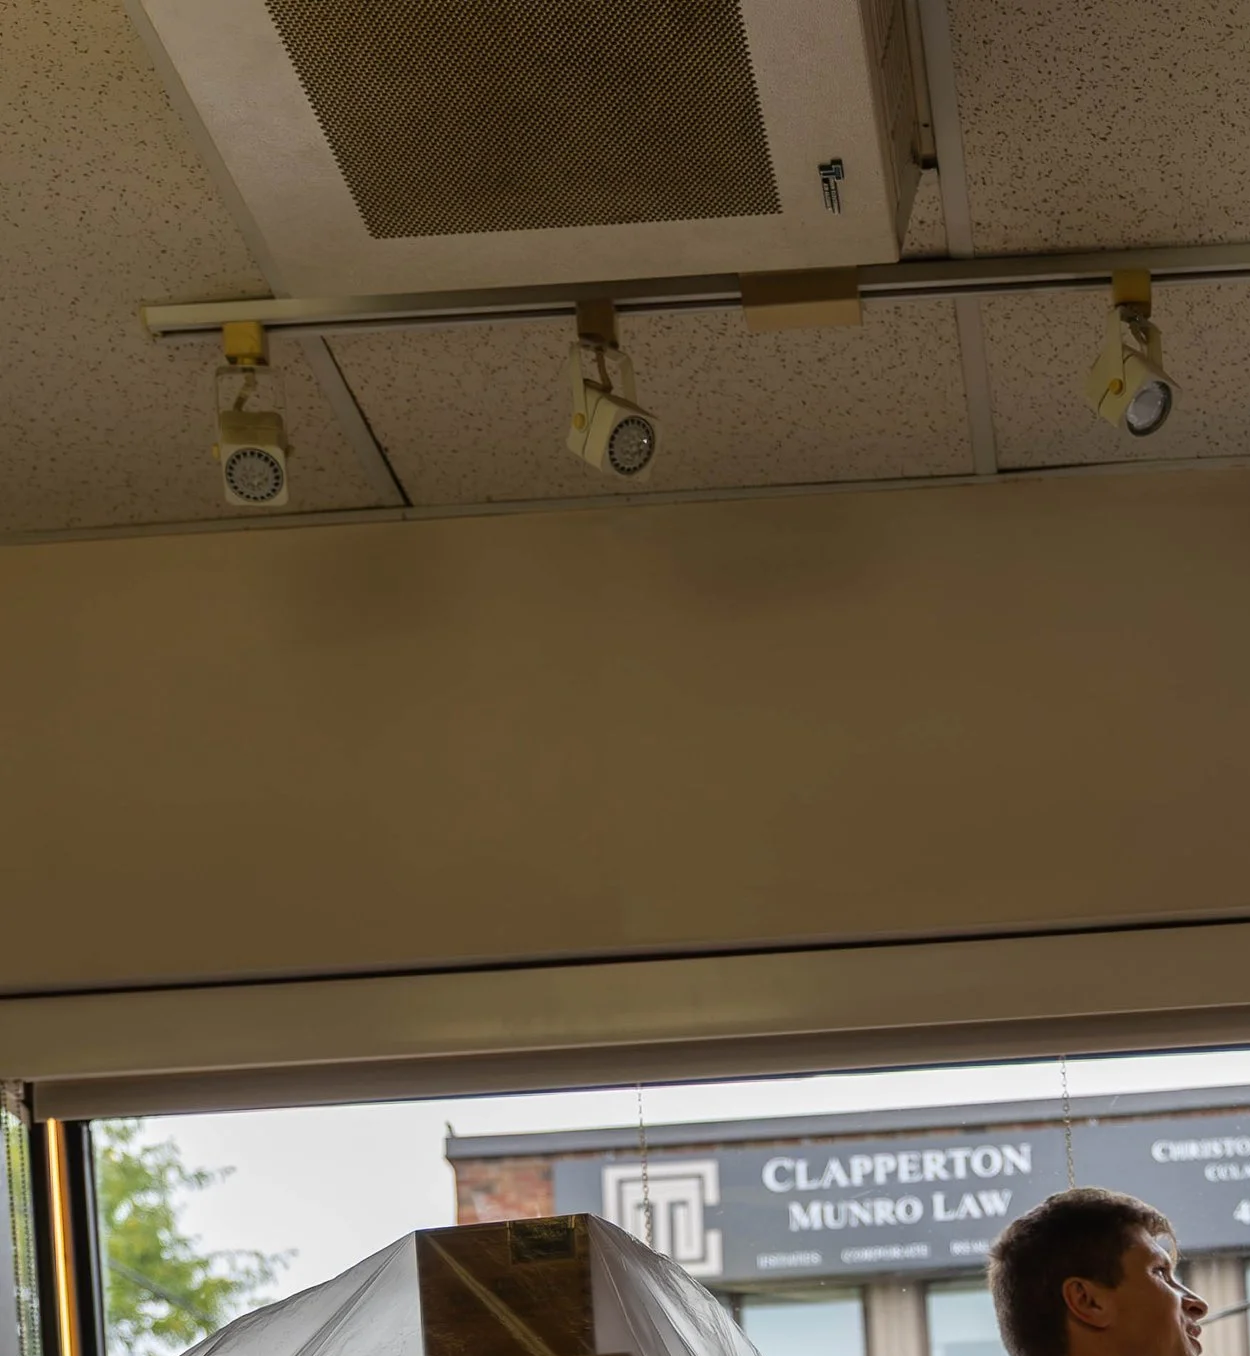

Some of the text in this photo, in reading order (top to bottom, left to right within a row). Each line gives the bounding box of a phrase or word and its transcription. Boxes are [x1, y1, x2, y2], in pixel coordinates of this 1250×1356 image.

[762, 1144, 1031, 1192] CLAPPERTON
[788, 1189, 1013, 1232] MUNRO LAW
